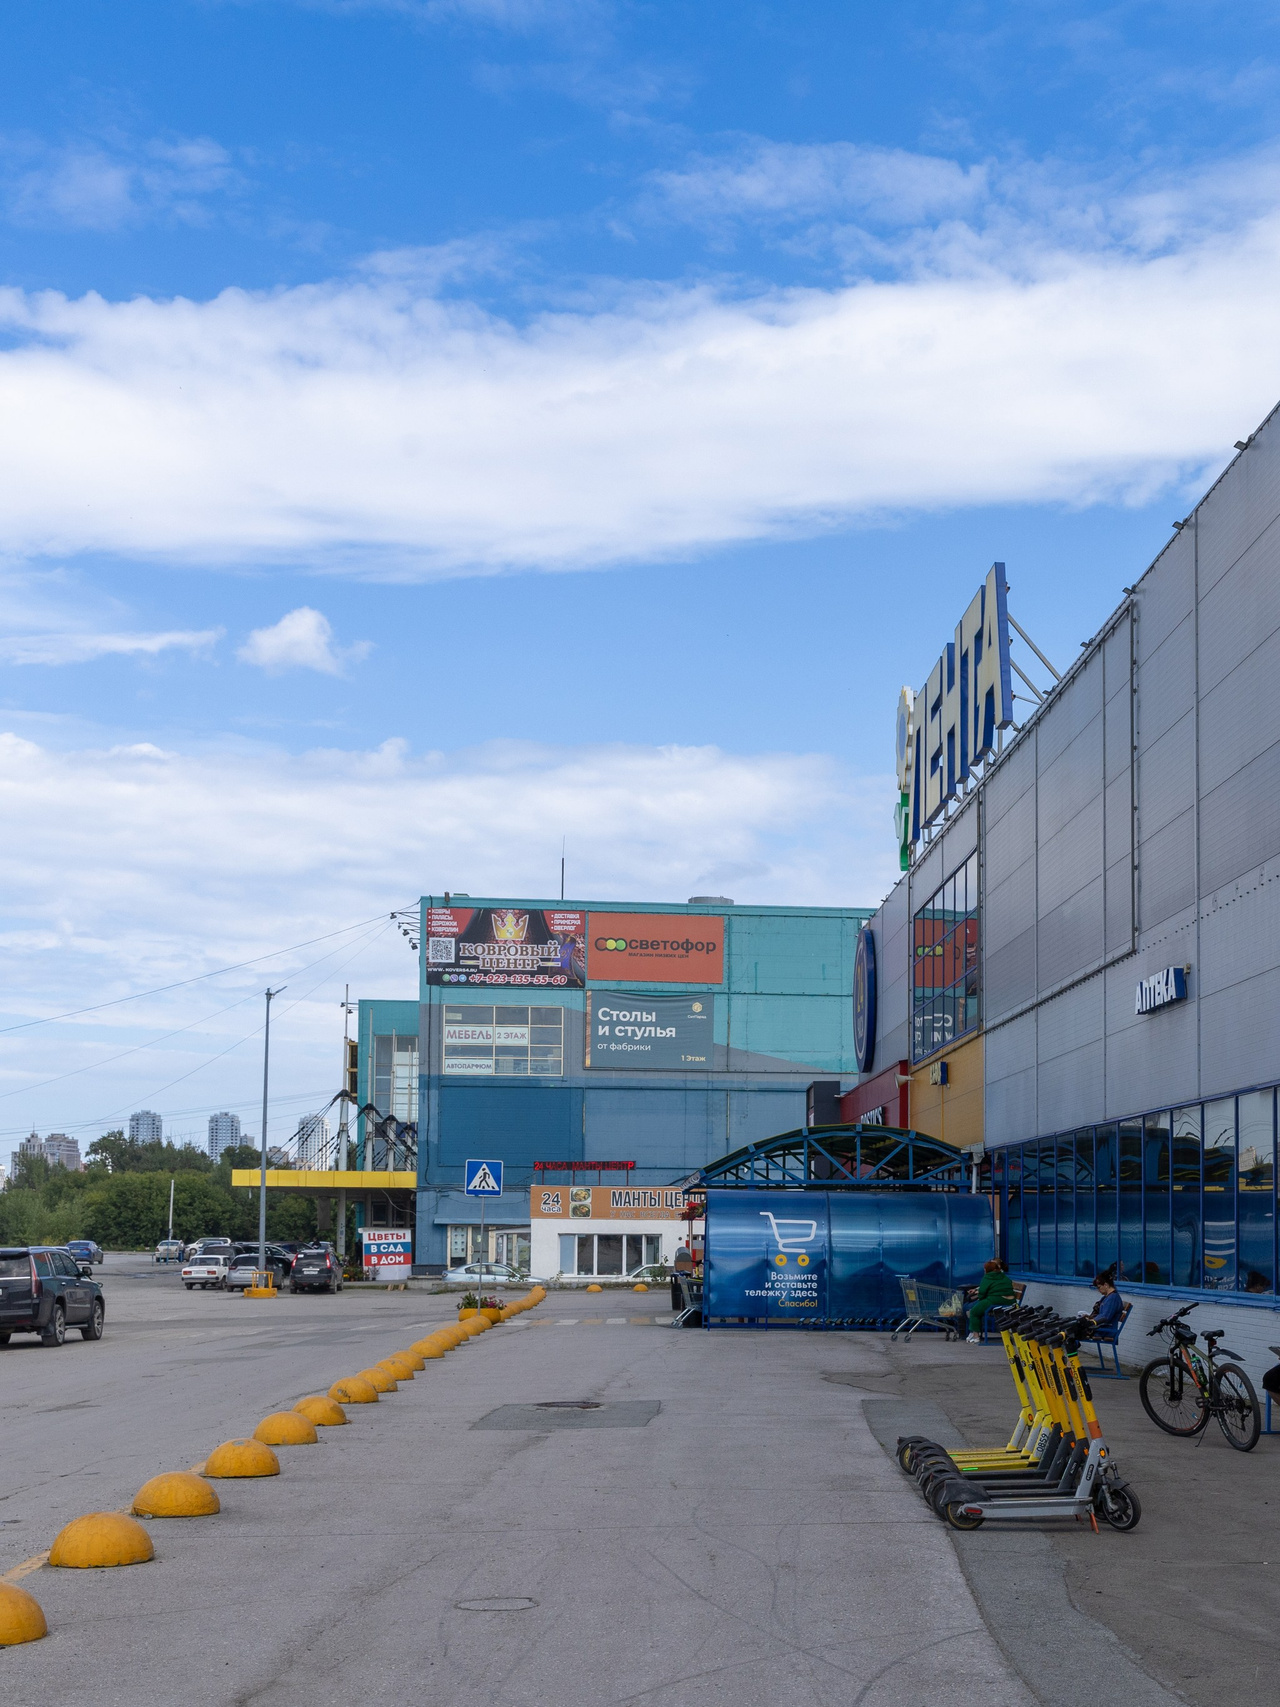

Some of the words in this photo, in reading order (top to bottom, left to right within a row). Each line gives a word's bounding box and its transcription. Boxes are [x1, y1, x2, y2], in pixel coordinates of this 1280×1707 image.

[908, 561, 1013, 846] ЛЕНТА
[460, 940, 560, 958] КОВРОВЫЙ
[628, 938, 717, 954] светофор
[480, 957, 541, 972] ЦЕНТР
[468, 973, 567, 985] +7-923-135-55-60
[1135, 966, 1177, 1015] АПТЕКА
[597, 1007, 656, 1022] Столы
[446, 1029, 492, 1040] МЕБЕЛЬ
[598, 1025, 609, 1036] и
[614, 1026, 676, 1040] стулья
[609, 1042, 651, 1052] фабрики
[534, 1161, 543, 1170] 24
[545, 1161, 567, 1170] ЧАСА
[572, 1161, 602, 1170] МАНТЫ
[605, 1161, 634, 1170] ЦЕНТР
[541, 1192, 561, 1206] 24
[610, 1190, 661, 1207] МАНТЫ
[541, 1205, 562, 1213] часа
[367, 1232, 406, 1241] ЦВЕТЫ
[371, 1244, 378, 1253] В
[380, 1243, 404, 1253] САД
[371, 1256, 378, 1265] В
[380, 1255, 404, 1264] ДОМ
[771, 1271, 818, 1280] Возьмите
[774, 1281, 818, 1289] оставьте
[744, 1289, 788, 1299] тележку
[790, 1290, 818, 1298] здесь
[778, 1298, 818, 1307] Спасибо!
[1069, 1360, 1084, 1398] WHOOSH
